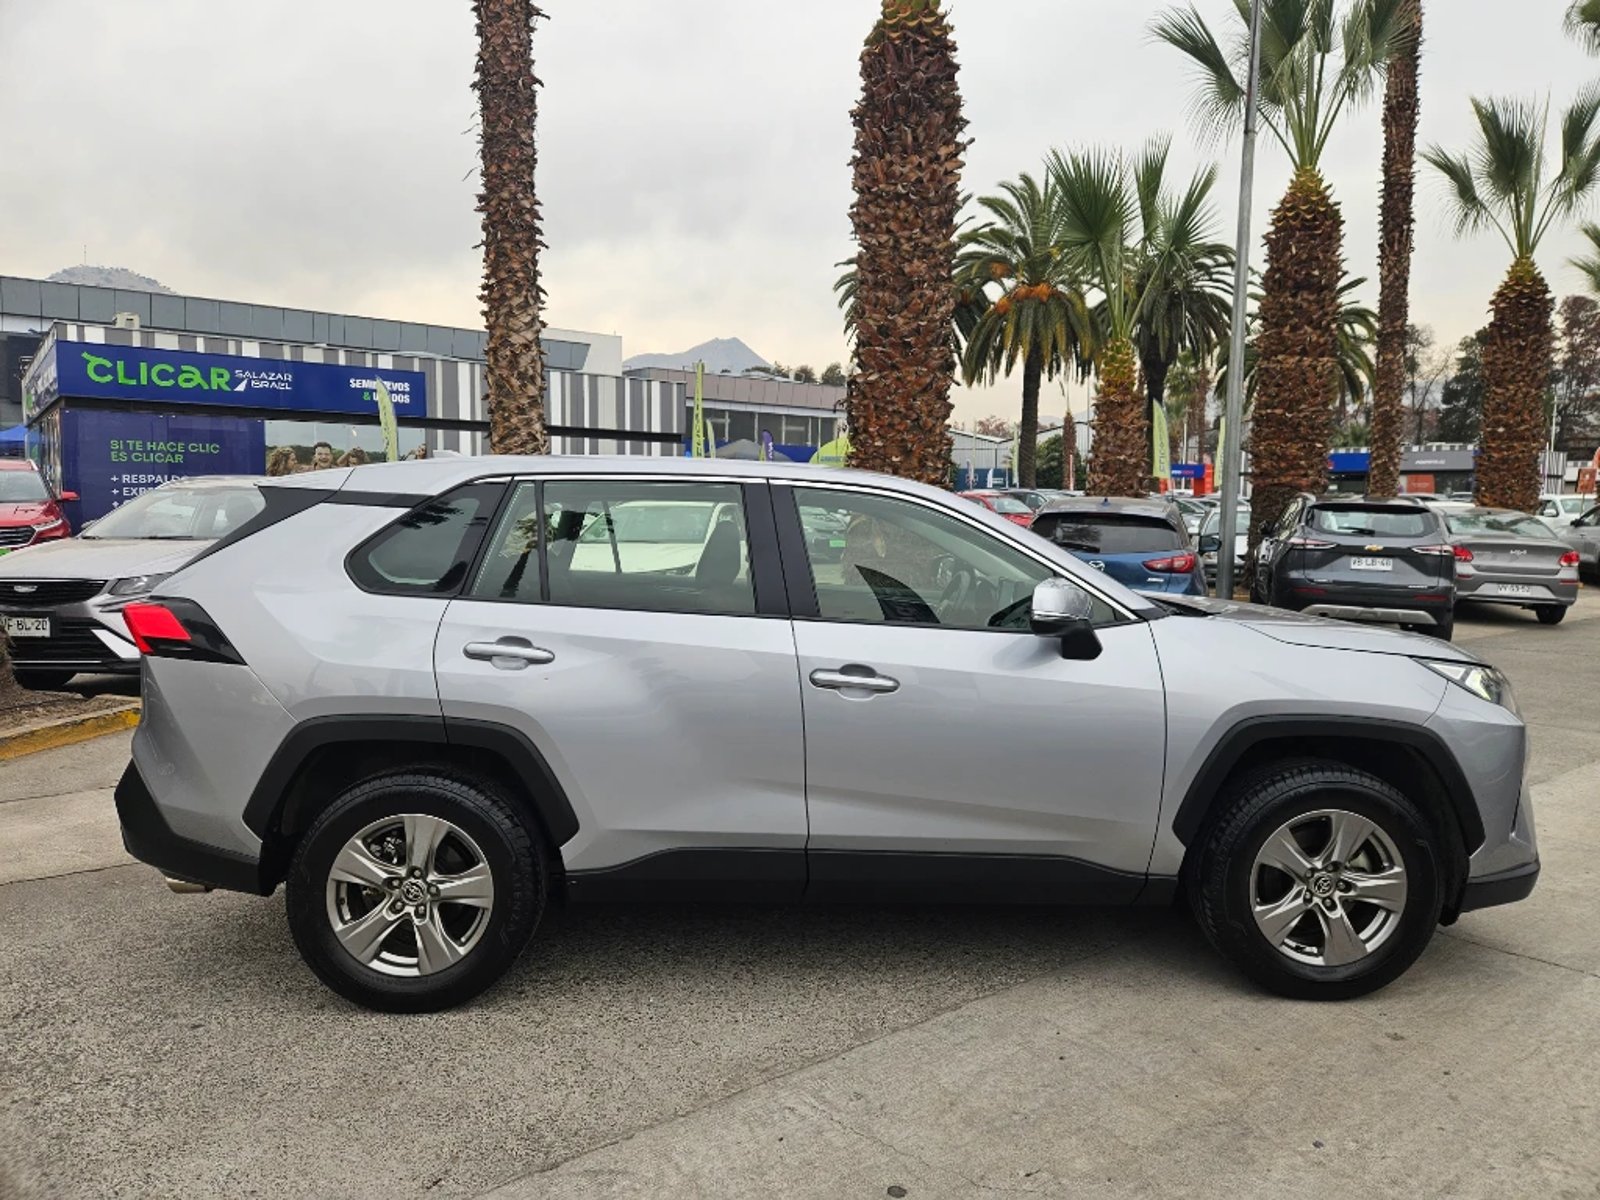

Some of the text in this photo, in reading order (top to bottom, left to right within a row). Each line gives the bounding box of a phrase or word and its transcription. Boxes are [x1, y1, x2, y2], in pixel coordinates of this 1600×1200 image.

[235, 370, 292, 381] SALAZAR
[373, 392, 410, 403] UDOS
[110, 440, 220, 454] SI TE HACE CLIC
[111, 451, 184, 464] ES CLICAR
